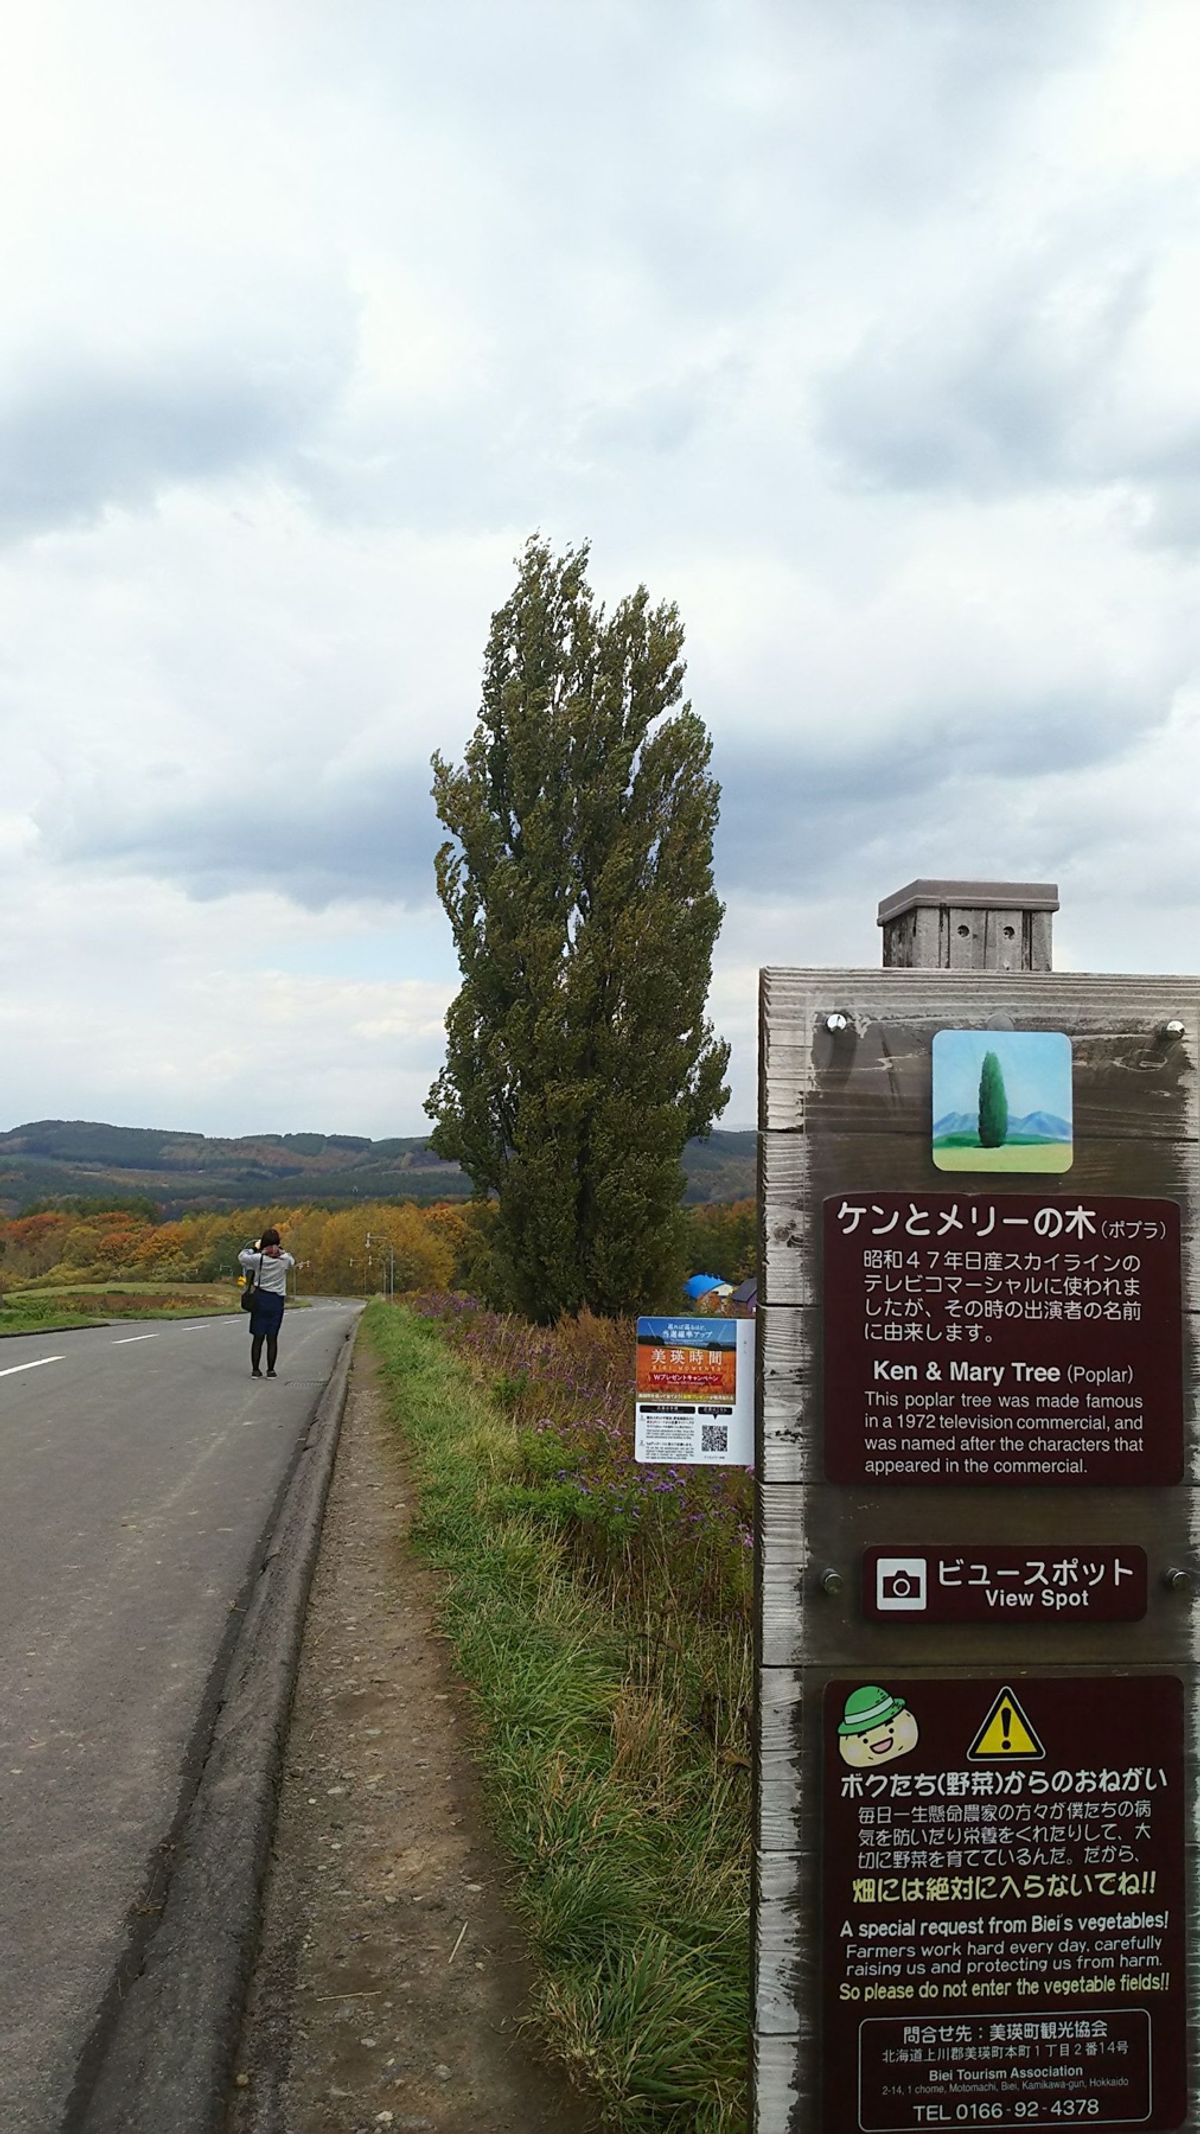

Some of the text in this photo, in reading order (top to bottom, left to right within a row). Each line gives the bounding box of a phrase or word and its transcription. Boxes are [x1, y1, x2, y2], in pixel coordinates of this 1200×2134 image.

[838, 1202, 1096, 1239] ケンとメリーの木
[864, 1275, 1140, 1296] テレビコマーシャルに使われま
[864, 1298, 1142, 1321] したが、その時の出演者の名前
[865, 1322, 992, 1342] に由来します。
[651, 1349, 722, 1365] 美瑛時間
[874, 1361, 1133, 1386] Ken & Mary Tree (Poplar)
[865, 1391, 1143, 1410] This poplar tree was made famous
[865, 1413, 1142, 1432] in a 1972 television commercial, and
[865, 1436, 1143, 1451] was named after the characters that
[865, 1458, 1087, 1475] appeared in the commercial.
[940, 1558, 1133, 1586] ビュースポット
[986, 1589, 1088, 1610] View Spot
[858, 1823, 1151, 1847] 気を防いだり栄養をくれたりして、大
[840, 1921, 853, 1937] A
[859, 1919, 915, 1939] special
[920, 1917, 984, 1937] request
[989, 1917, 1026, 1933] from
[1078, 1911, 1168, 1932] vegetables!
[847, 1945, 915, 1958] Farmers
[921, 1942, 961, 1956] work
[968, 1941, 1004, 1955] hard
[1010, 1943, 1053, 1954] every
[1095, 1936, 1162, 1951] carefully
[847, 1954, 1162, 1976] raising us and protecting us from harm.
[840, 1973, 1169, 2001] So please do not enter the vegetable fields!!
[930, 2065, 1083, 2081] Biei Tourism Association
[1090, 2077, 1128, 2087] Hokkaido
[913, 2105, 951, 2121] TEL
